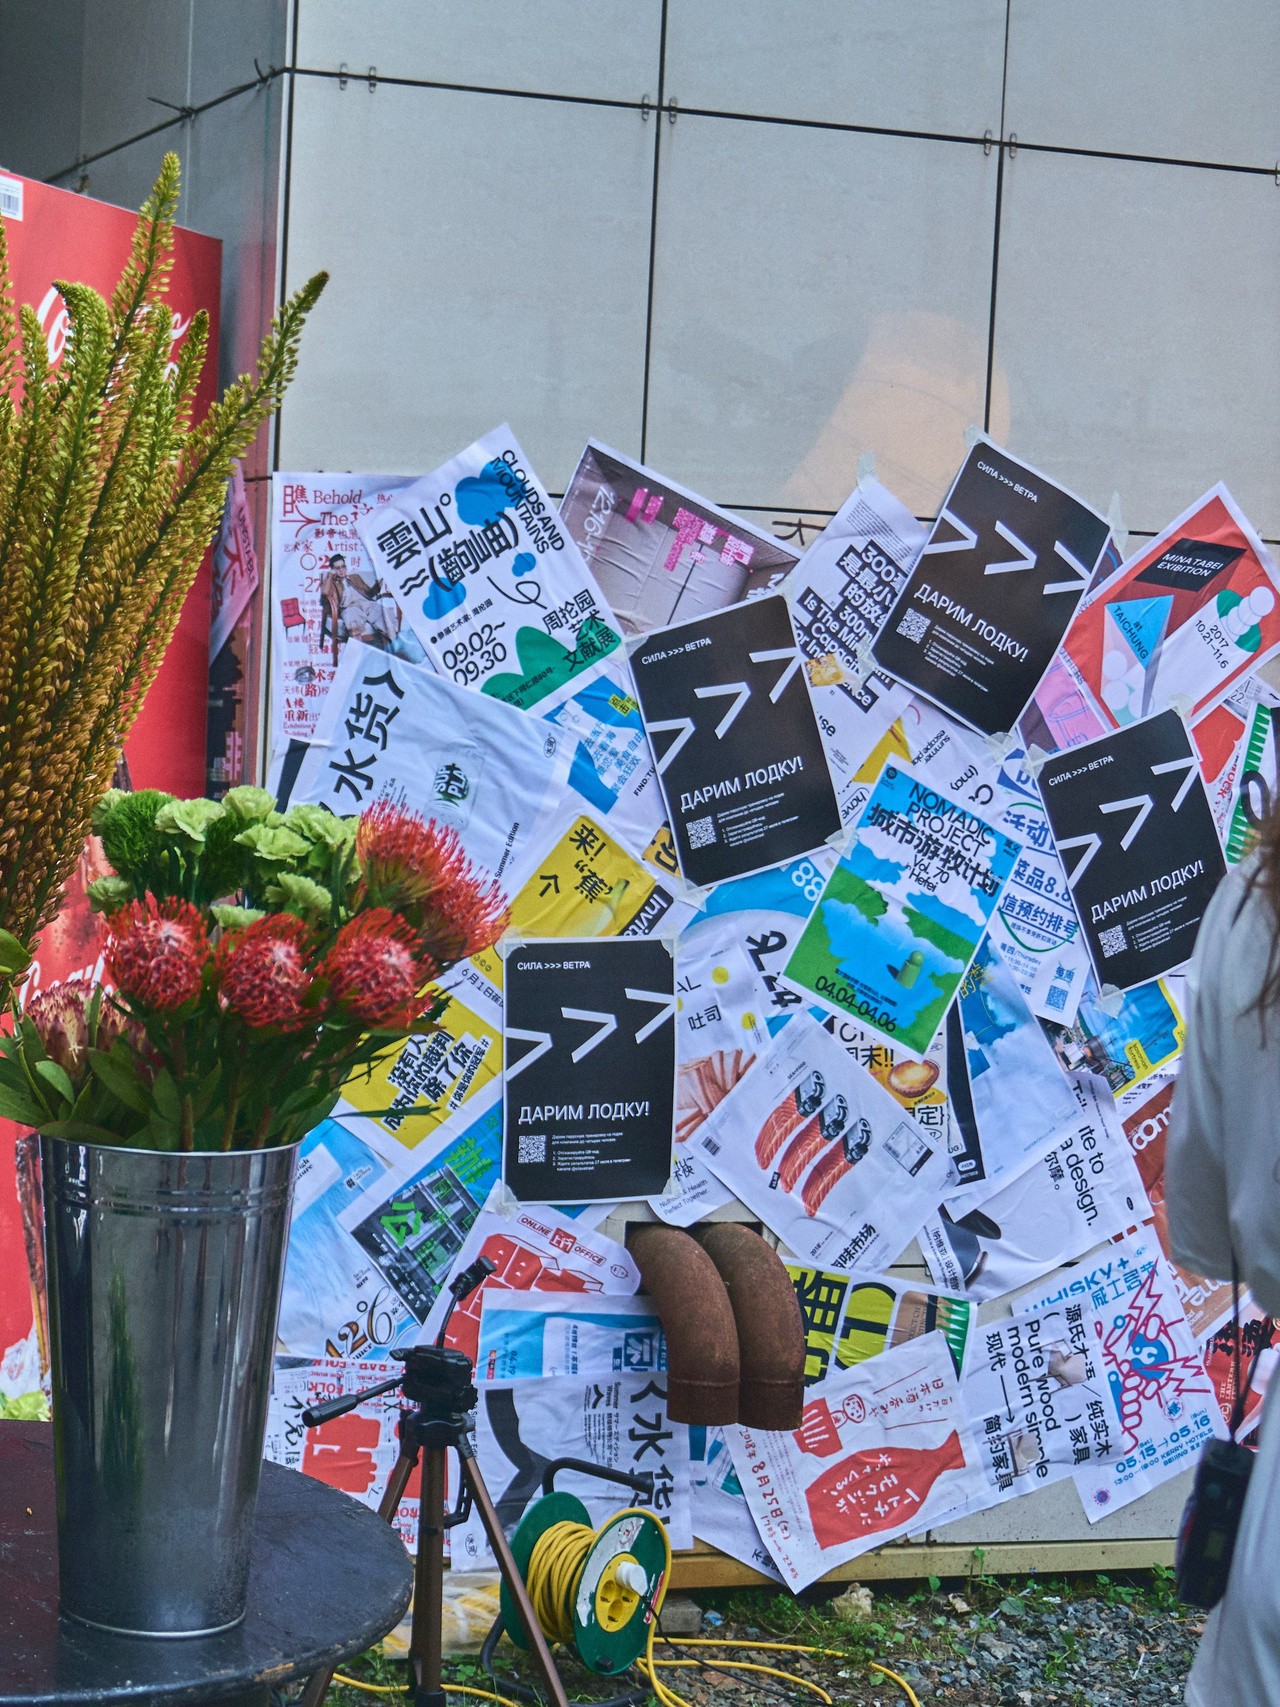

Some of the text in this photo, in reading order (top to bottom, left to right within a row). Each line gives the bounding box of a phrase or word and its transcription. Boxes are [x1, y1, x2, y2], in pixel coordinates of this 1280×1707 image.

[313, 489, 363, 504] Behold
[502, 449, 565, 551] CLOUDS AND
[976, 461, 1038, 503] СИЛА ВЕТРА
[320, 511, 349, 526] The
[490, 456, 550, 554] MOUNTAINS
[1156, 561, 1213, 577] EXIBITION
[1162, 553, 1224, 571] MINA TABEI
[568, 609, 606, 642] 艺术
[803, 593, 839, 633] Is The
[913, 583, 1030, 663] ДАРИМ ЛОДКУ!
[1113, 604, 1149, 661] TAICHUNG
[1133, 620, 1143, 631] at
[562, 626, 618, 672] 文献展
[642, 637, 712, 665] СИЛА ВЕТРА
[1209, 624, 1230, 649] 2017
[680, 755, 804, 813] ДАРИМ ЛОДКУ!
[1048, 754, 1114, 787] СИЛА ВЕТРА
[907, 802, 986, 858] PROJECT
[908, 783, 995, 846] NOMADIC
[494, 822, 520, 879] Summer Edition
[869, 803, 1004, 899] 城市游牧计划
[913, 854, 951, 886] Vol. 70
[908, 869, 940, 893] Hefei
[1090, 858, 1206, 925] ДАРИМ ЛОДКУ!
[517, 960, 591, 971] СИЛА ВЕТРА
[687, 1005, 722, 1032] 吐司
[420, 1041, 473, 1103] 除了你
[518, 1101, 650, 1124] ДАРИМ ЛОДКУ!
[1088, 1155, 1105, 1175] to
[687, 1178, 709, 1193] Health
[1065, 1152, 1100, 1227] design.
[663, 1198, 684, 1216] Perfect
[520, 1216, 604, 1266] ONLINE OFFICE
[1090, 1260, 1161, 1312] 威士忌节
[986, 1333, 1007, 1372] 现代
[1006, 1325, 1036, 1408] modern
[309, 1381, 345, 1394] FOLK
[613, 1381, 622, 1409] Summer
[1024, 1319, 1061, 1432] Pure wood
[1219, 1382, 1227, 1400] THE
[1224, 1360, 1237, 1400] LANTERN
[605, 1384, 613, 1407] Waves
[1069, 1427, 1091, 1467] 家具
[1086, 1399, 1114, 1458] 纯实木
[1115, 1414, 1211, 1475] 05.15 05.16
[1183, 1427, 1214, 1449] HOTELS
